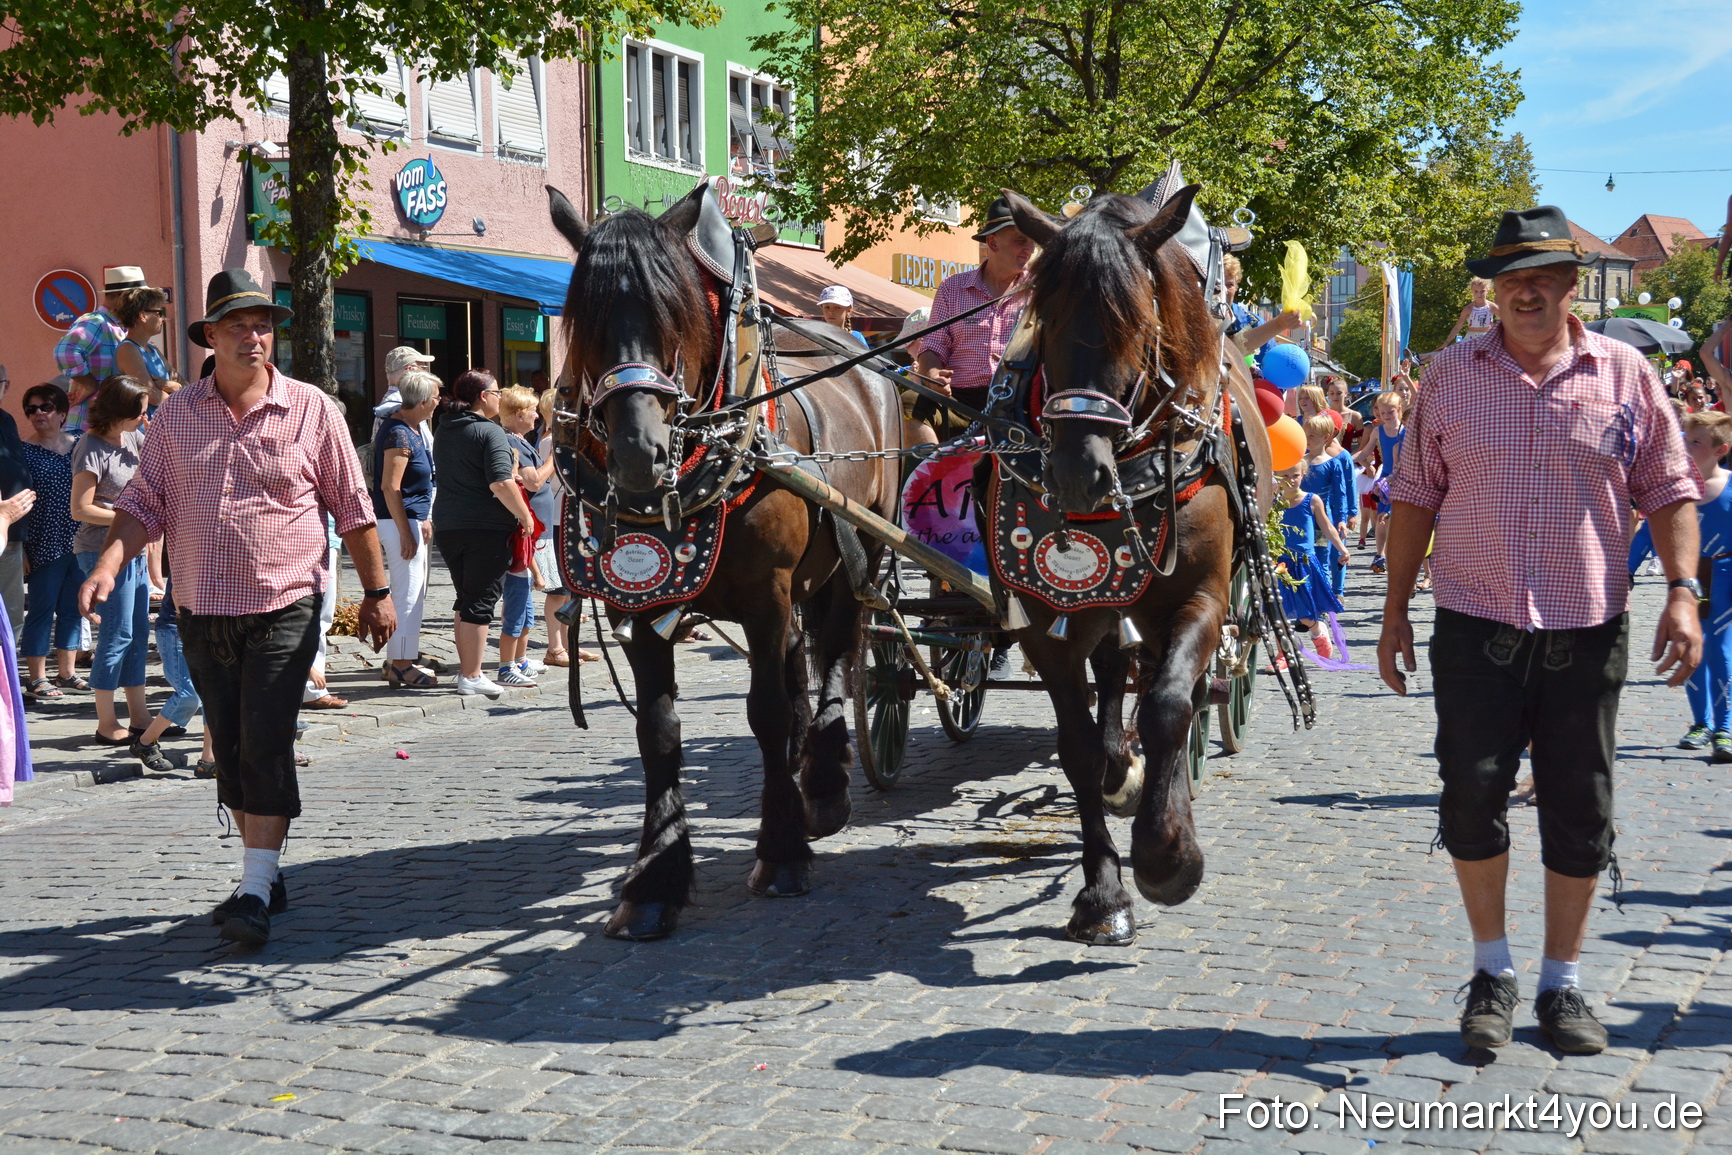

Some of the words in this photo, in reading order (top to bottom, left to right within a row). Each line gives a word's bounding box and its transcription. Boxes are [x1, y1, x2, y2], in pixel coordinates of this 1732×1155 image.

[396, 165, 424, 191] vom
[270, 188, 290, 205] FA
[407, 180, 447, 218] FASS
[900, 253, 936, 288] LEDER
[334, 305, 365, 326] Whisky
[407, 314, 440, 330] Feinkost
[506, 317, 524, 335] Essig
[917, 527, 958, 545] the
